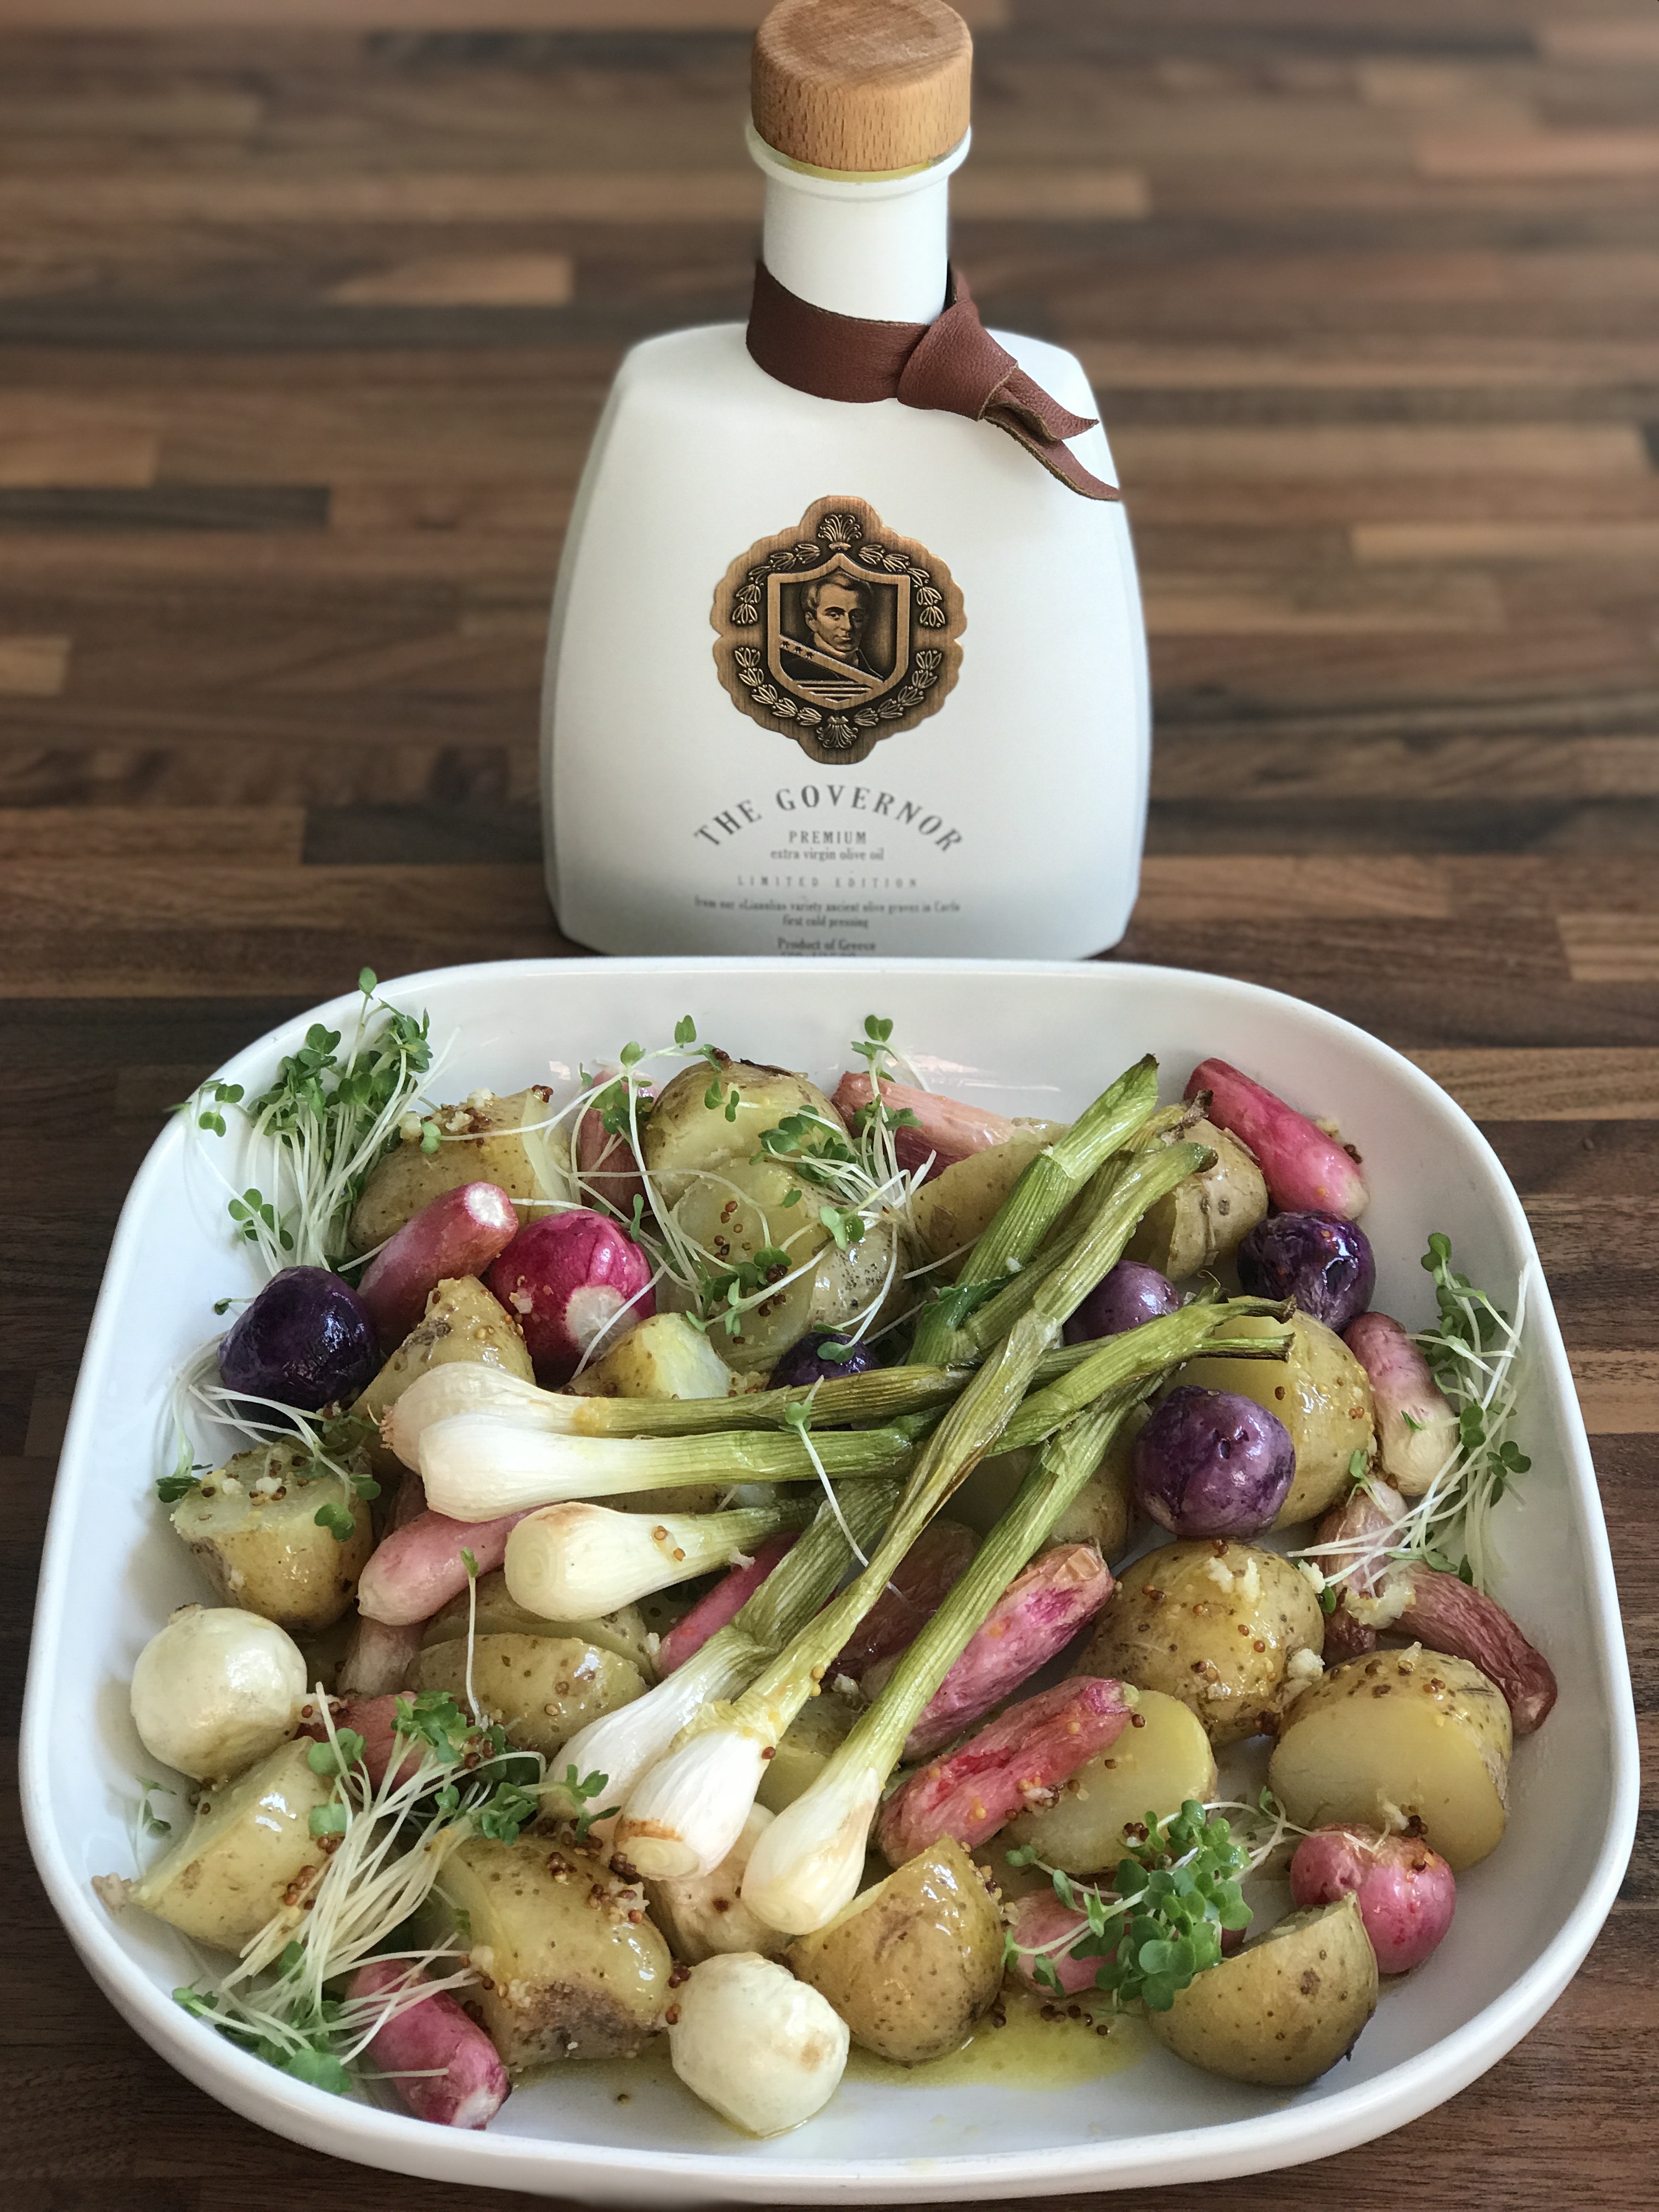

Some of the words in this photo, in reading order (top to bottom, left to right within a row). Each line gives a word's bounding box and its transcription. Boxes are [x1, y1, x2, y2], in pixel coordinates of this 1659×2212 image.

[694, 799, 763, 847] THE
[776, 785, 963, 853] GOVERNOR
[788, 830, 867, 844] PREMIUM
[770, 849, 800, 860] extra
[804, 848, 836, 862] virgin
[839, 848, 866, 860] olive
[869, 848, 885, 860] oil
[737, 876, 819, 887] LIMITED
[835, 877, 917, 889] EDITION
[791, 902, 822, 913] variety
[826, 900, 860, 912] ancient
[862, 900, 885, 913] olive
[782, 914, 803, 926] first
[805, 915, 826, 926] cold
[828, 917, 869, 929] pressing
[777, 937, 821, 950] Product
[823, 939, 836, 951] of
[838, 939, 876, 951] Greece
